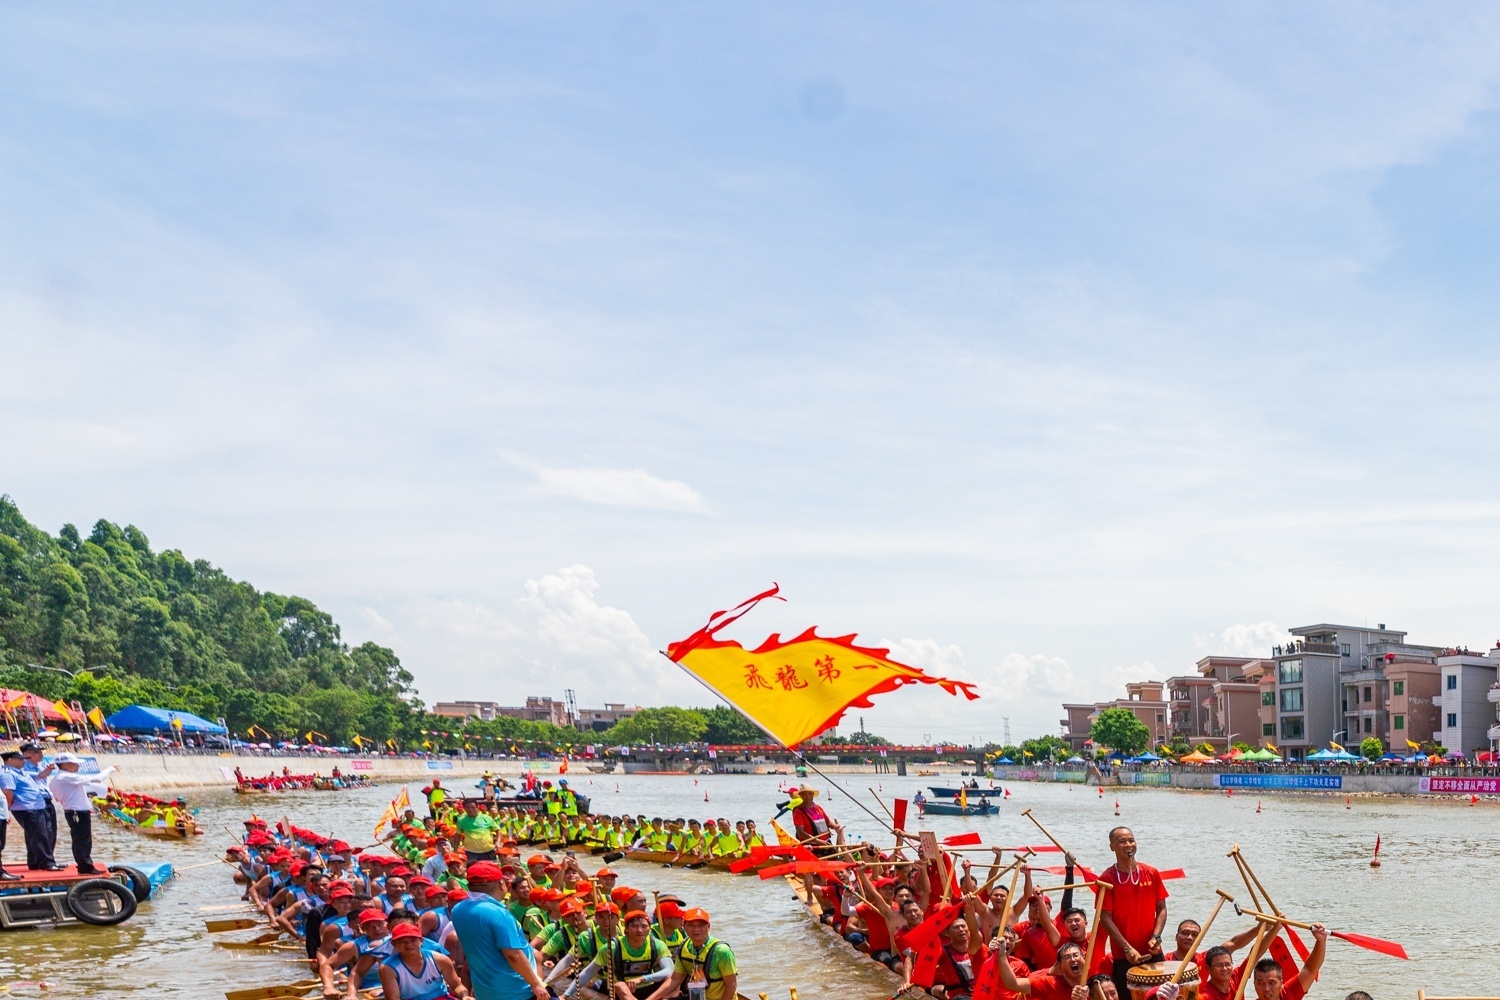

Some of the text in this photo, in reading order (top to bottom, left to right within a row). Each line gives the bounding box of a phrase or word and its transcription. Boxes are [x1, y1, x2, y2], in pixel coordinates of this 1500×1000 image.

[743, 654, 879, 691] 飛龍第一
[1432, 780, 1497, 792] 坚定不移全面从严治党
